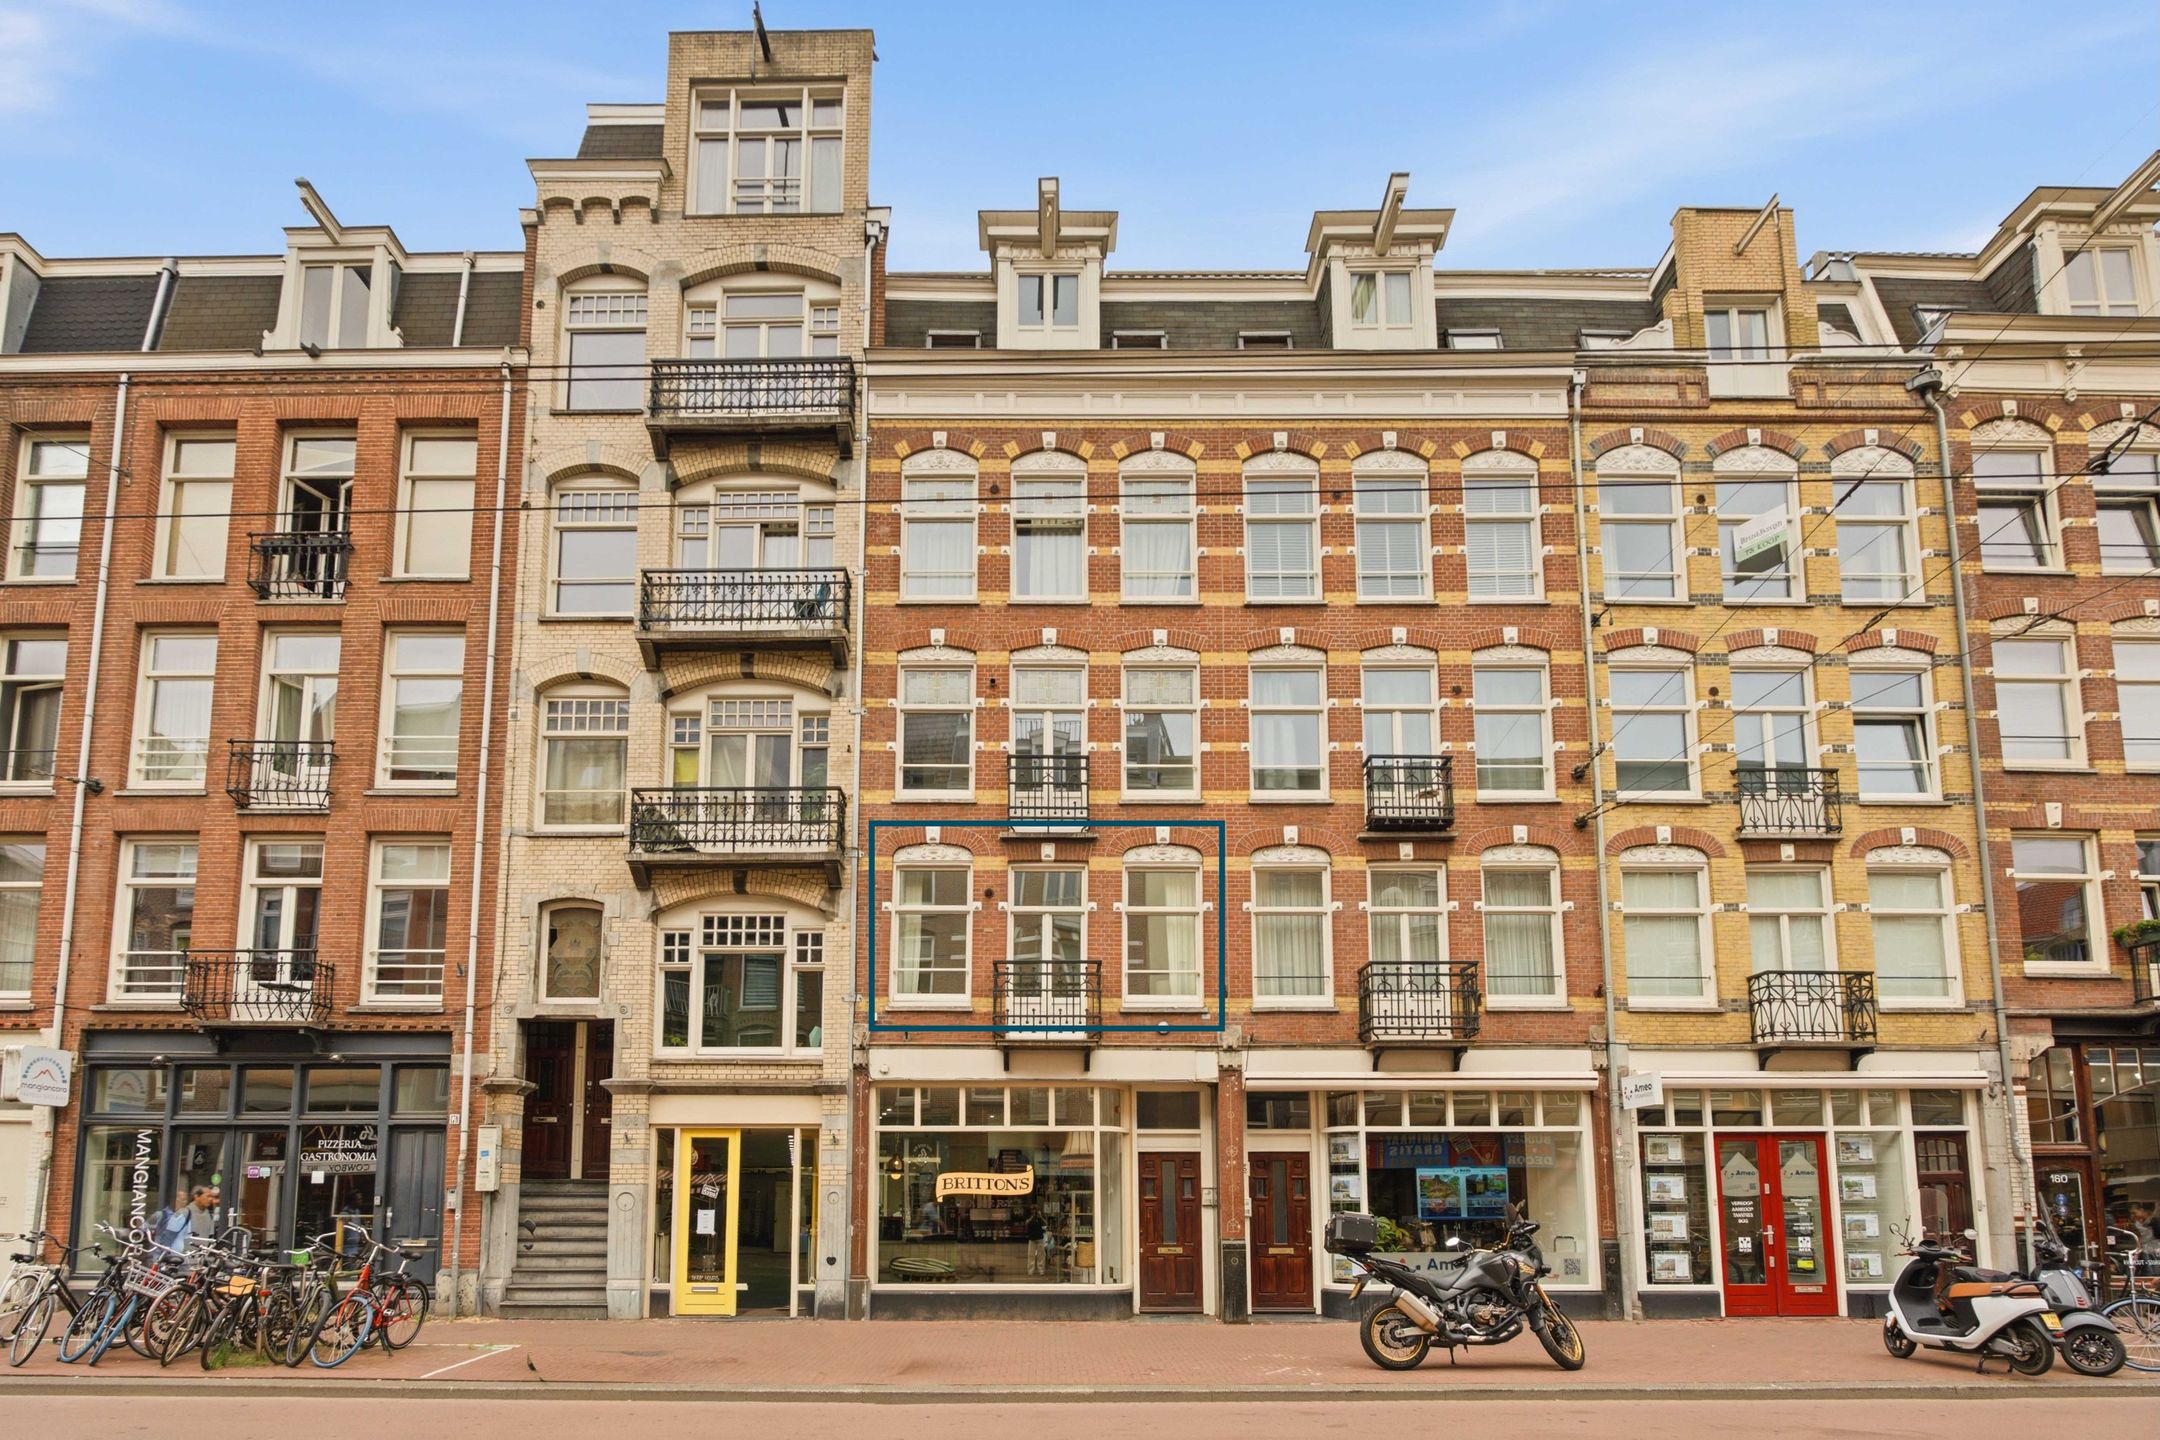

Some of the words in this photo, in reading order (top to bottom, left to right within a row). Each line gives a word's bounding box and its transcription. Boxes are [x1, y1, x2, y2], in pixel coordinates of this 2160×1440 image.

[1634, 1083, 1653, 1093] Ameo
[318, 1139, 362, 1149] PIZZERIA
[300, 1152, 376, 1161] GASTRONOMIA
[2050, 1174, 2068, 1184] 160
